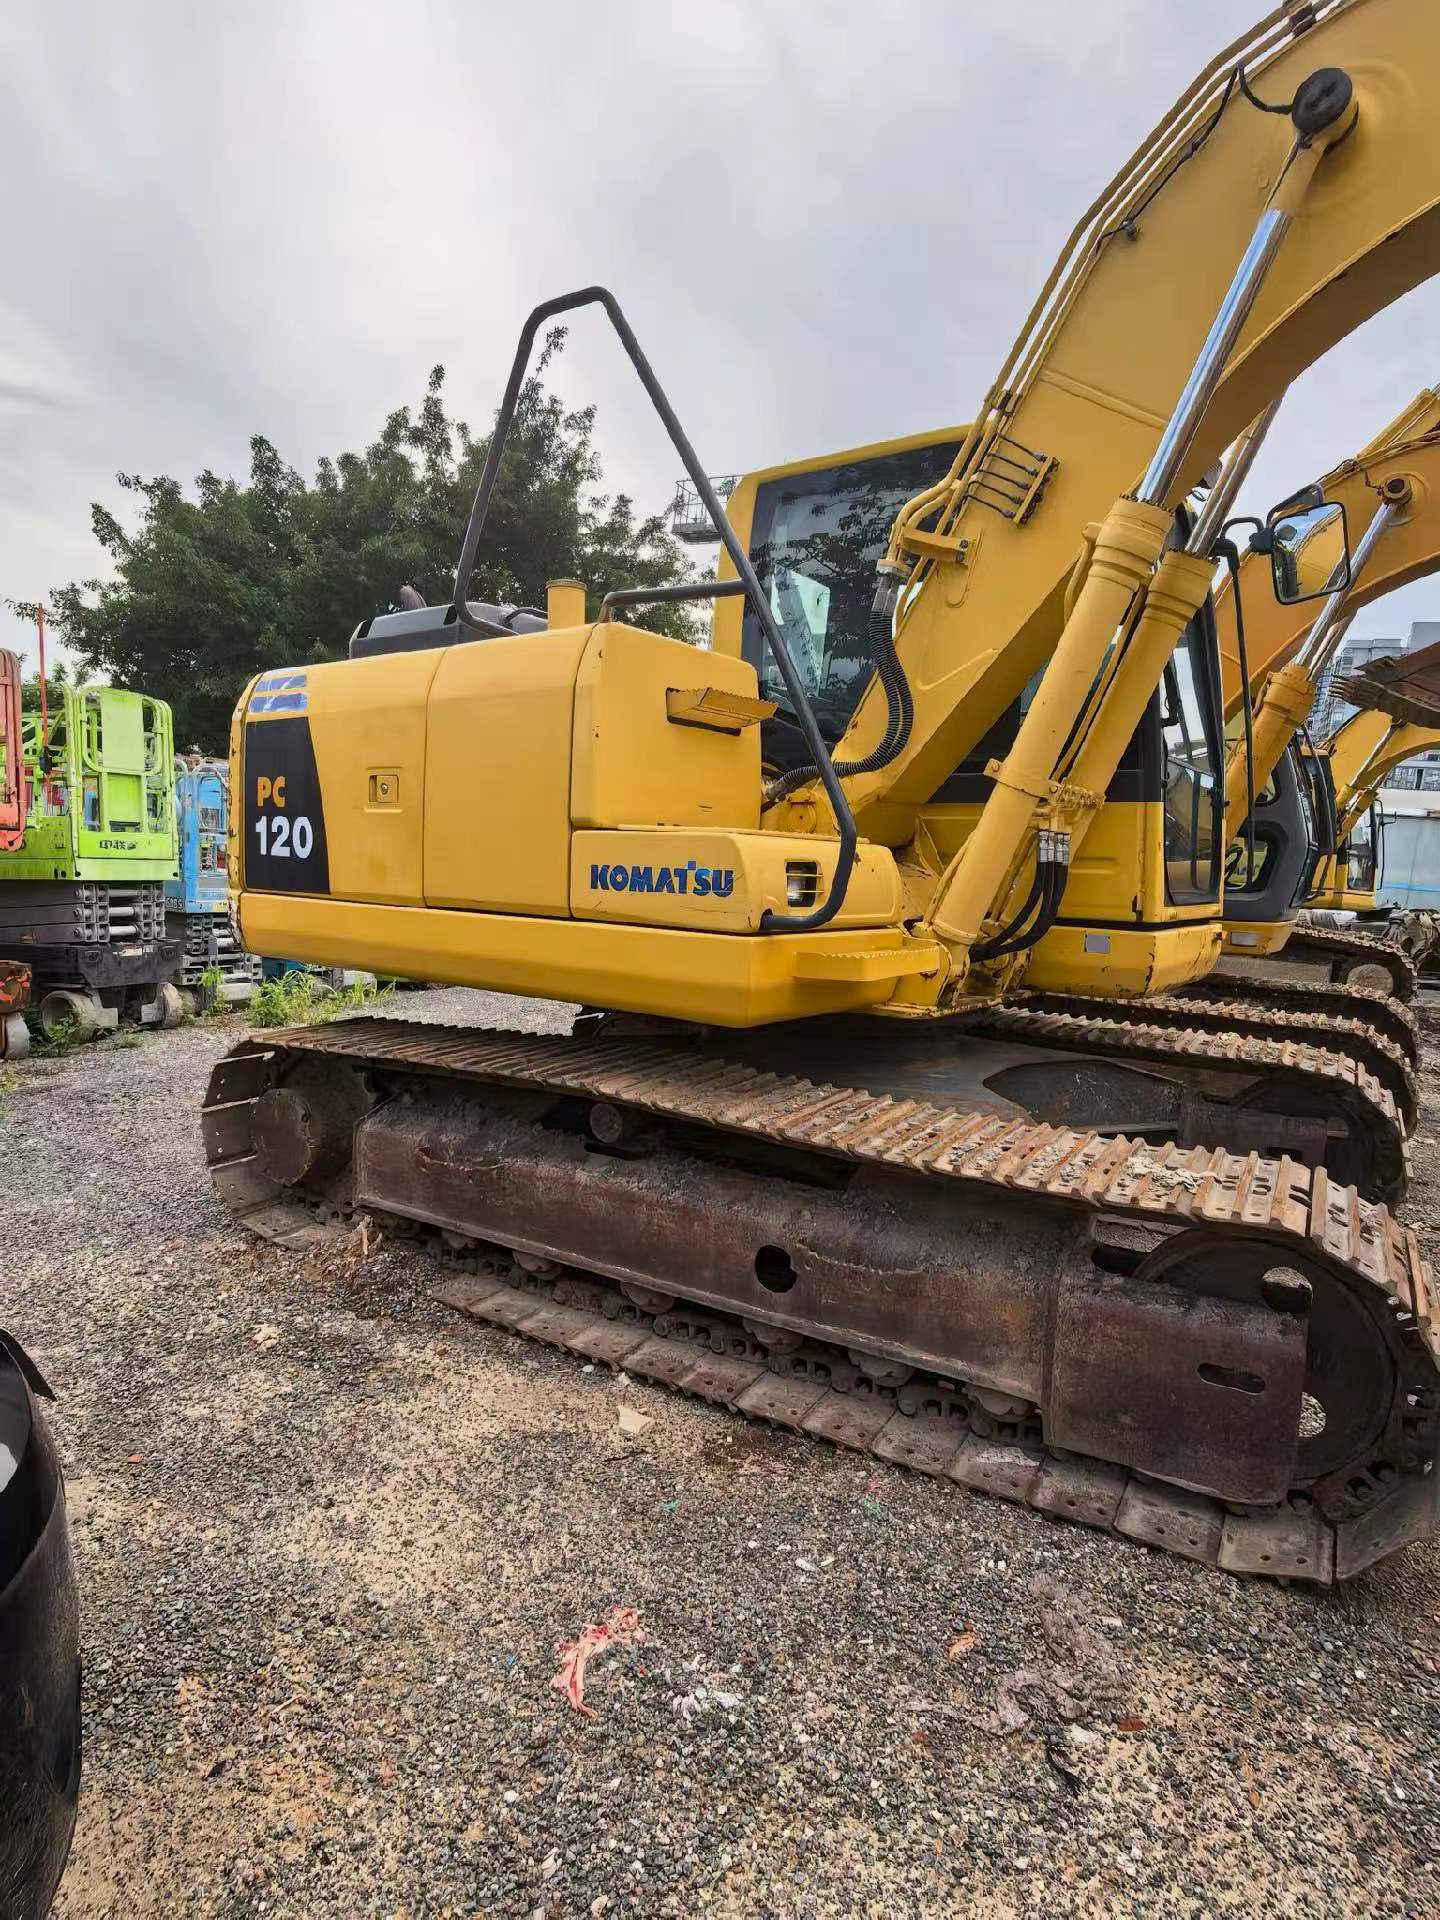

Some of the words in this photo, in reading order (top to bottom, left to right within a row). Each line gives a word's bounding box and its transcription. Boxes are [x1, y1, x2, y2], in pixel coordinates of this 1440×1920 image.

[257, 776, 286, 808] PC
[255, 815, 314, 859] 120
[590, 860, 734, 898] KOMATSU
